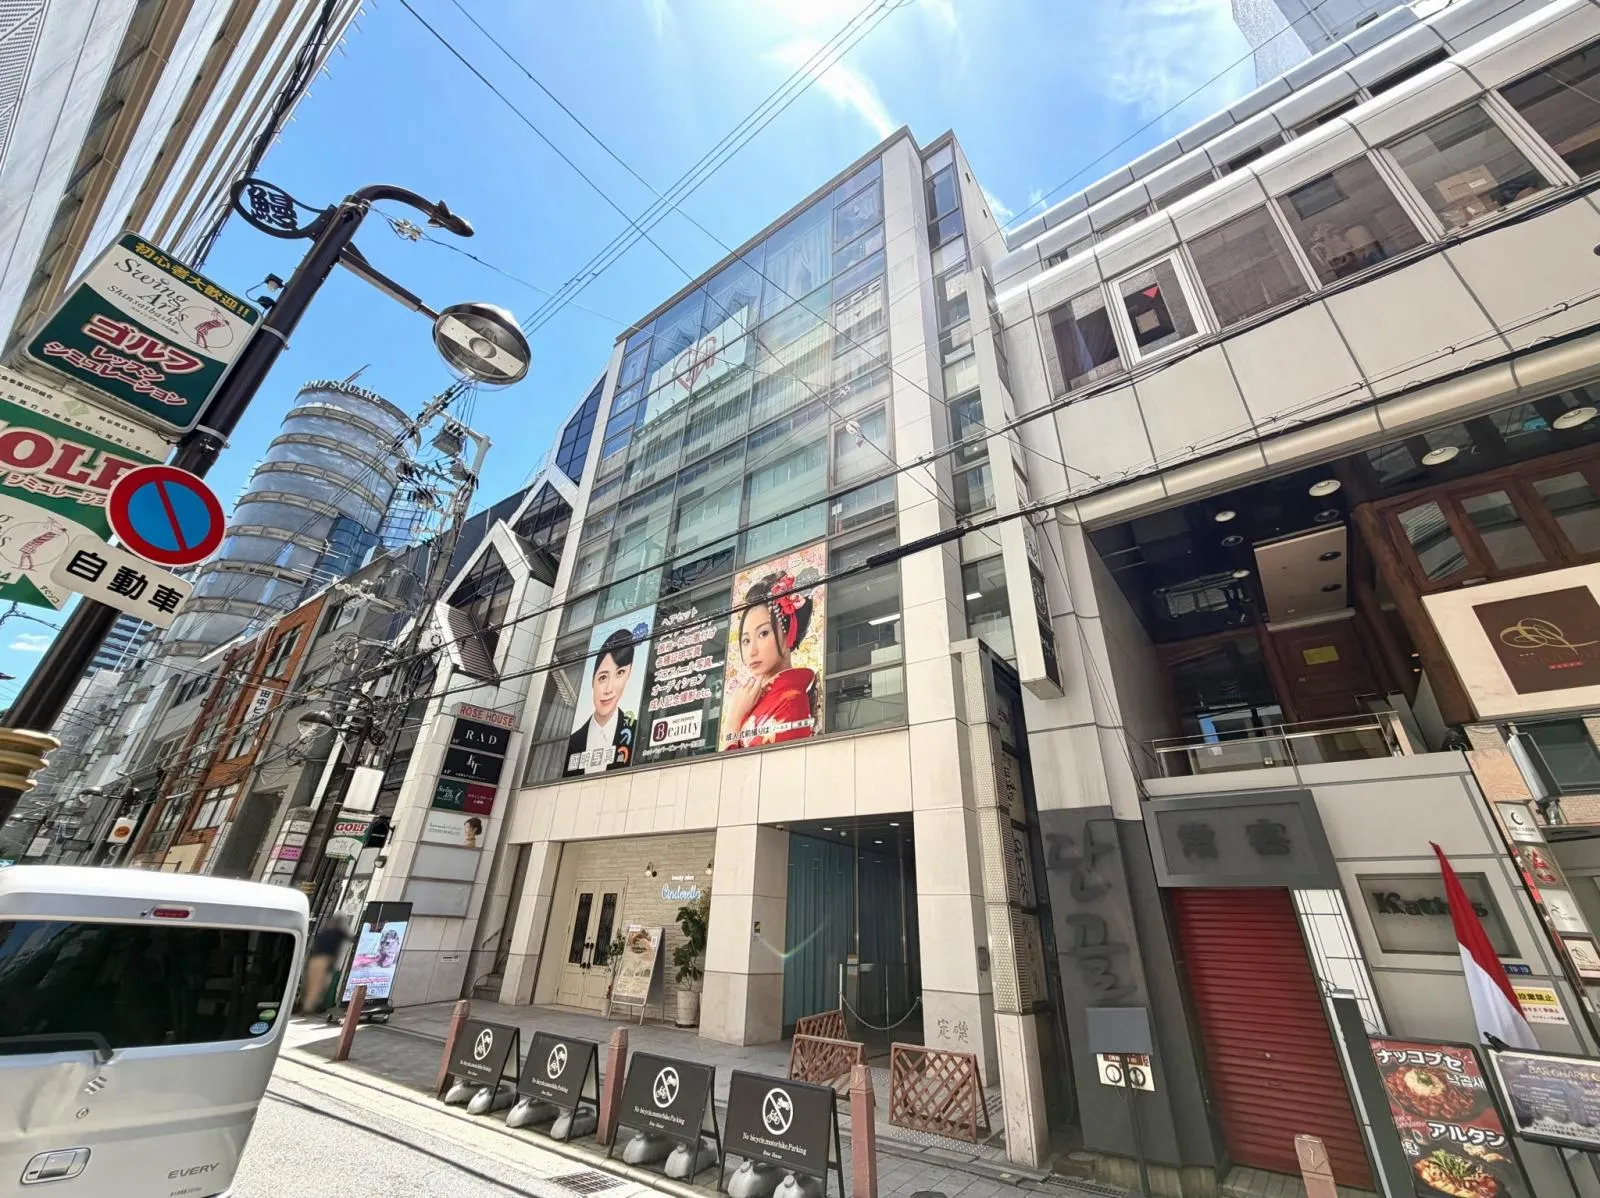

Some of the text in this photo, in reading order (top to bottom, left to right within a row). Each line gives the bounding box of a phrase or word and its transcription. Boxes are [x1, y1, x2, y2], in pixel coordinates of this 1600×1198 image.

[114, 257, 188, 308] Swing
[106, 285, 178, 328] Shinsaibashi
[136, 293, 189, 322] Arts
[84, 314, 203, 373] ゴルフ
[43, 340, 188, 407] シミュレーション
[91, 345, 165, 382] レッスン
[329, 381, 383, 404] SQUARE
[65, 548, 183, 615] 自動車
[459, 706, 514, 728] ROSE HOUSE
[653, 720, 699, 743] Beauty
[334, 822, 370, 833] GOLF
[1376, 1048, 1464, 1074] ナッコプセ
[1428, 1121, 1507, 1150] アルタン
[168, 1162, 220, 1179] EVERY
